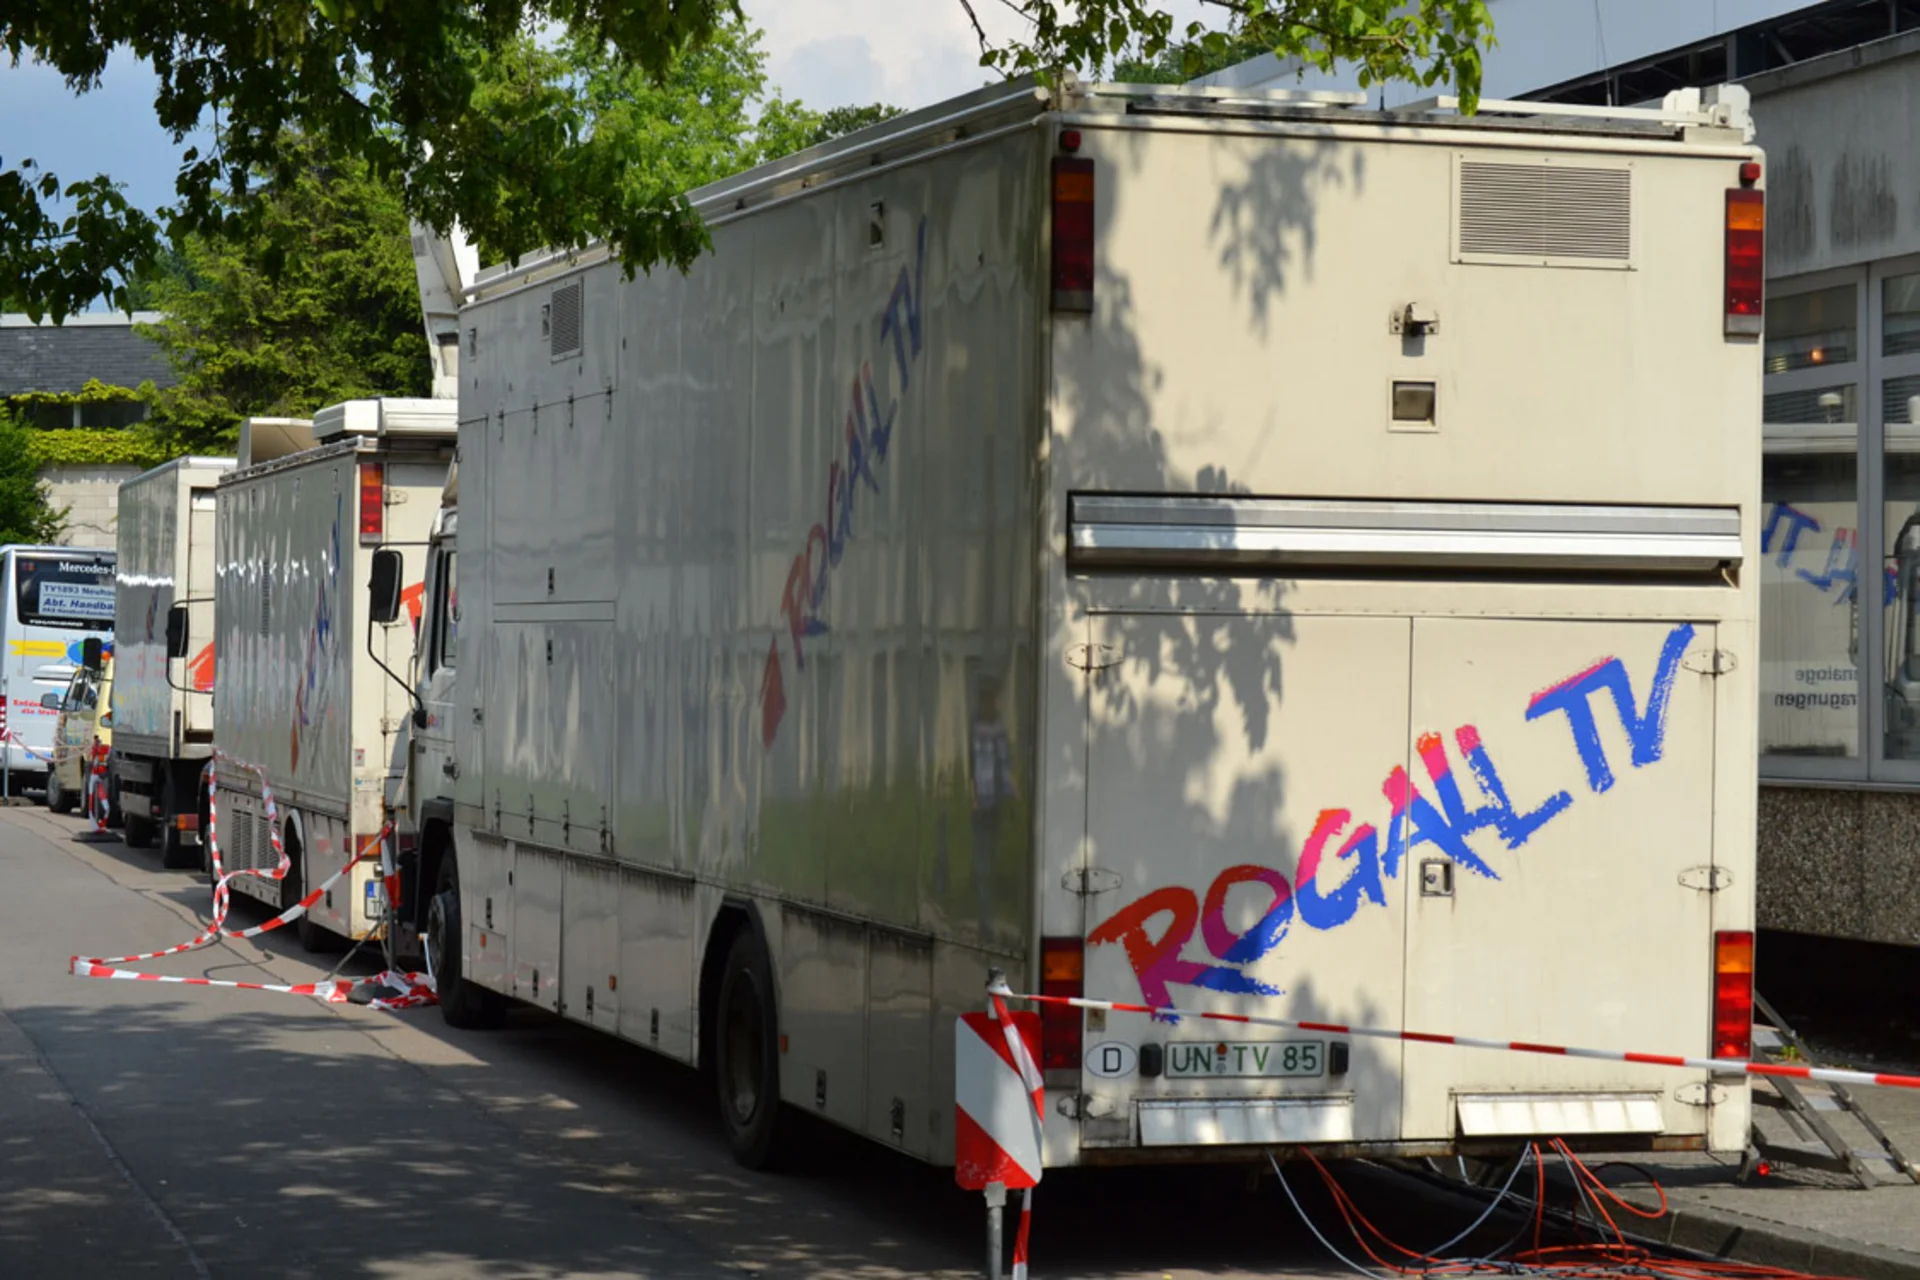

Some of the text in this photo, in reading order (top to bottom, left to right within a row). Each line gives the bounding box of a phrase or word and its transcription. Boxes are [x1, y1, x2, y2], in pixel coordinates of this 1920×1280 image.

[58, 561, 115, 575] Mercedes-
[70, 600, 115, 611] Handba
[1087, 622, 1697, 1026] ROGALL TV
[1102, 1047, 1122, 1072] D
[1171, 1045, 1317, 1072] UN TV 85
